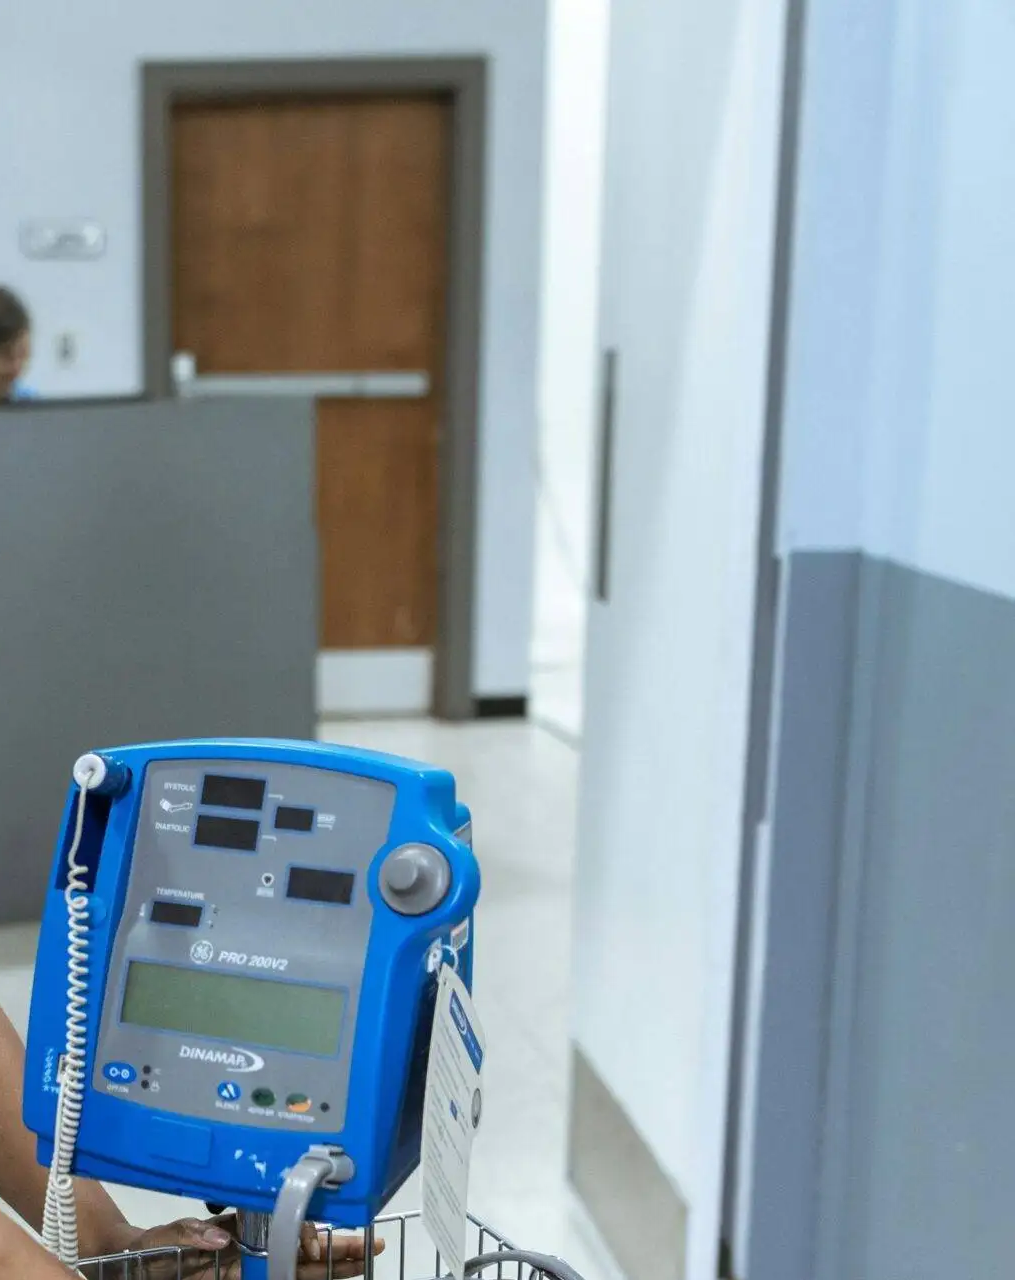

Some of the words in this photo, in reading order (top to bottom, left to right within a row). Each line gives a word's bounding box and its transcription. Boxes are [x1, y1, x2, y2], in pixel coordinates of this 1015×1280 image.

[163, 782, 196, 792] SYSTOLIC
[155, 821, 191, 833] DIASTOLIC
[156, 887, 205, 900] TEMPERATURE
[218, 950, 247, 966] PRO
[248, 955, 289, 971] 200V2
[178, 1044, 245, 1066] DINAMAP
